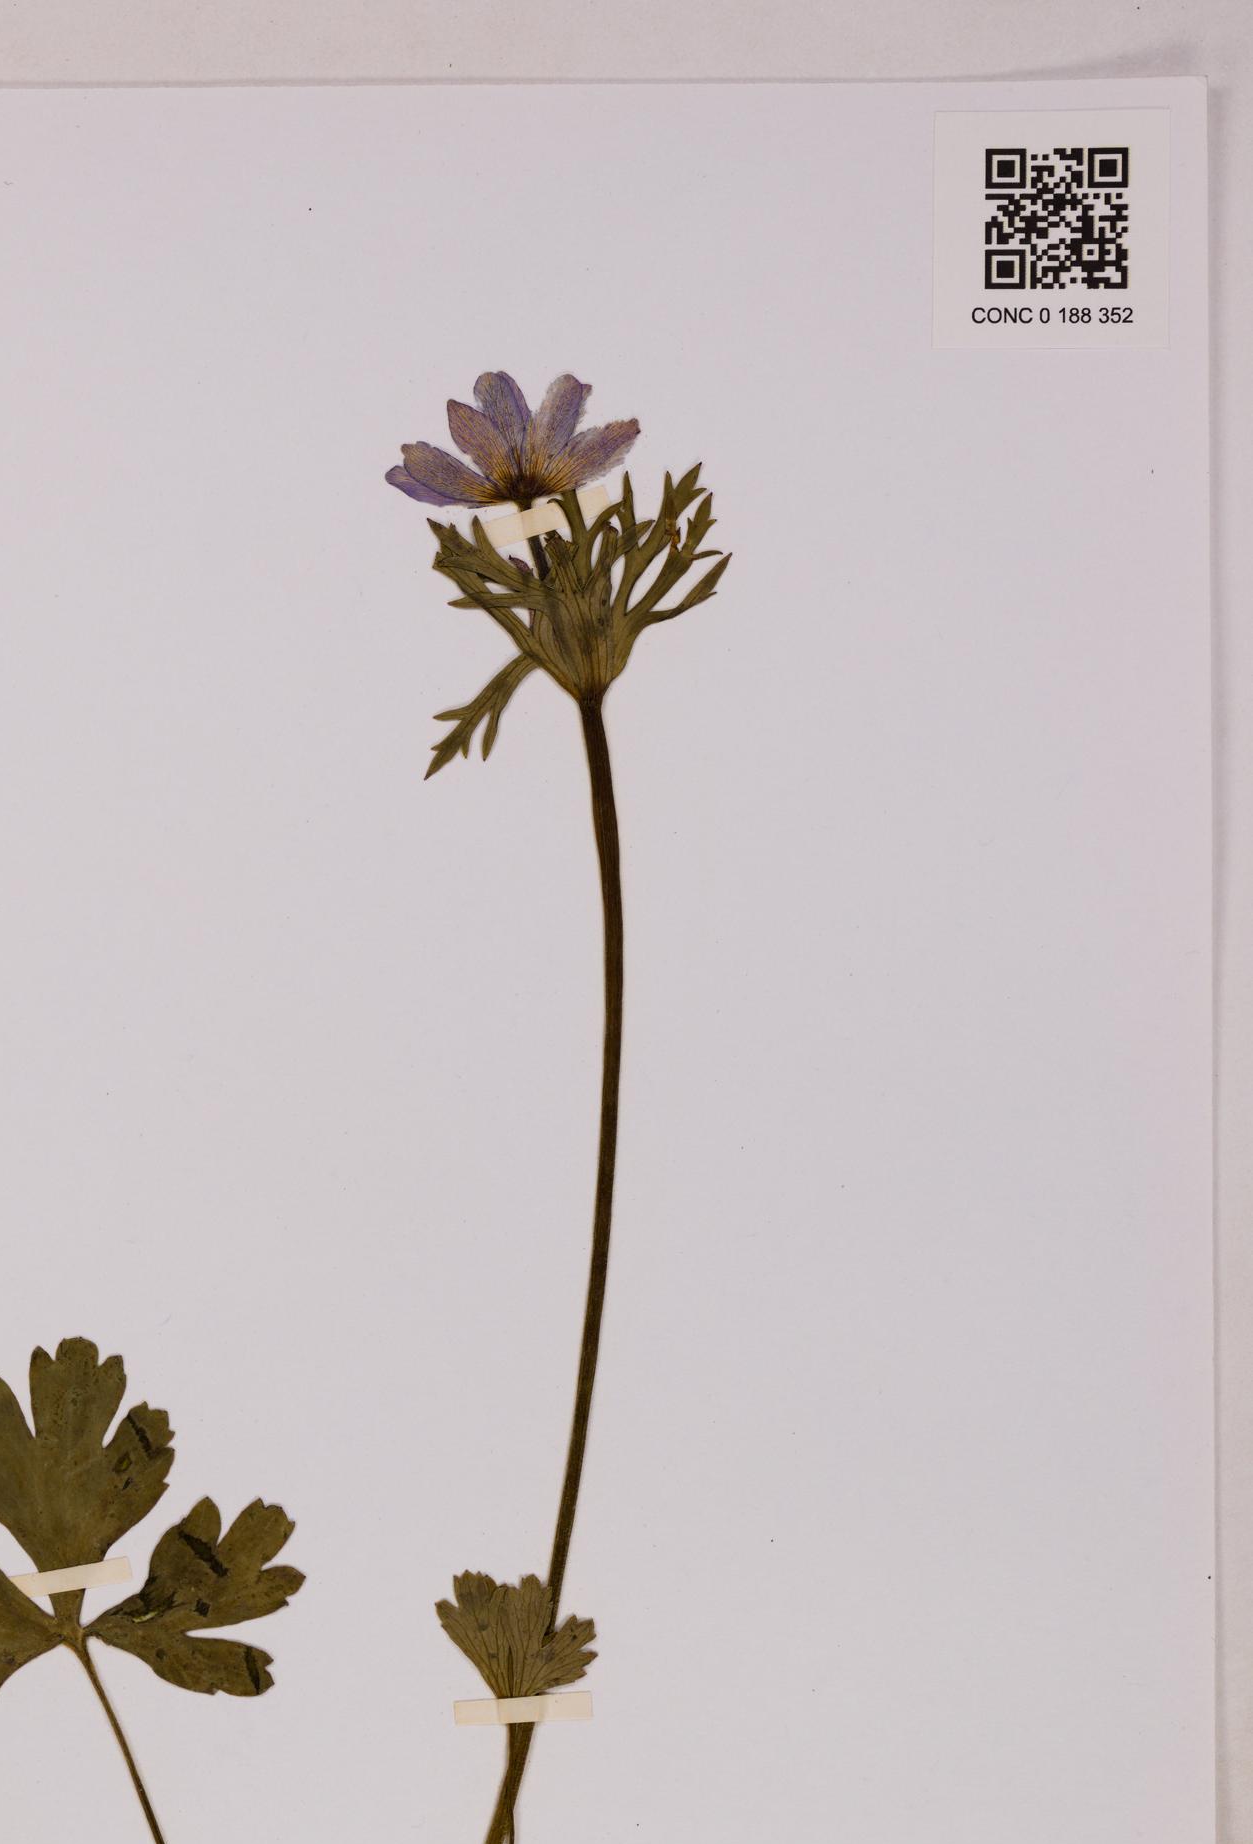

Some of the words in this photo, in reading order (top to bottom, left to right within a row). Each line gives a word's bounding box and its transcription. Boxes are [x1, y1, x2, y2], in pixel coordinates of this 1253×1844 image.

[972, 308, 1033, 323] CONC
[1040, 308, 1050, 323] 0
[1059, 308, 1091, 323] 188
[1099, 307, 1133, 323] 352
